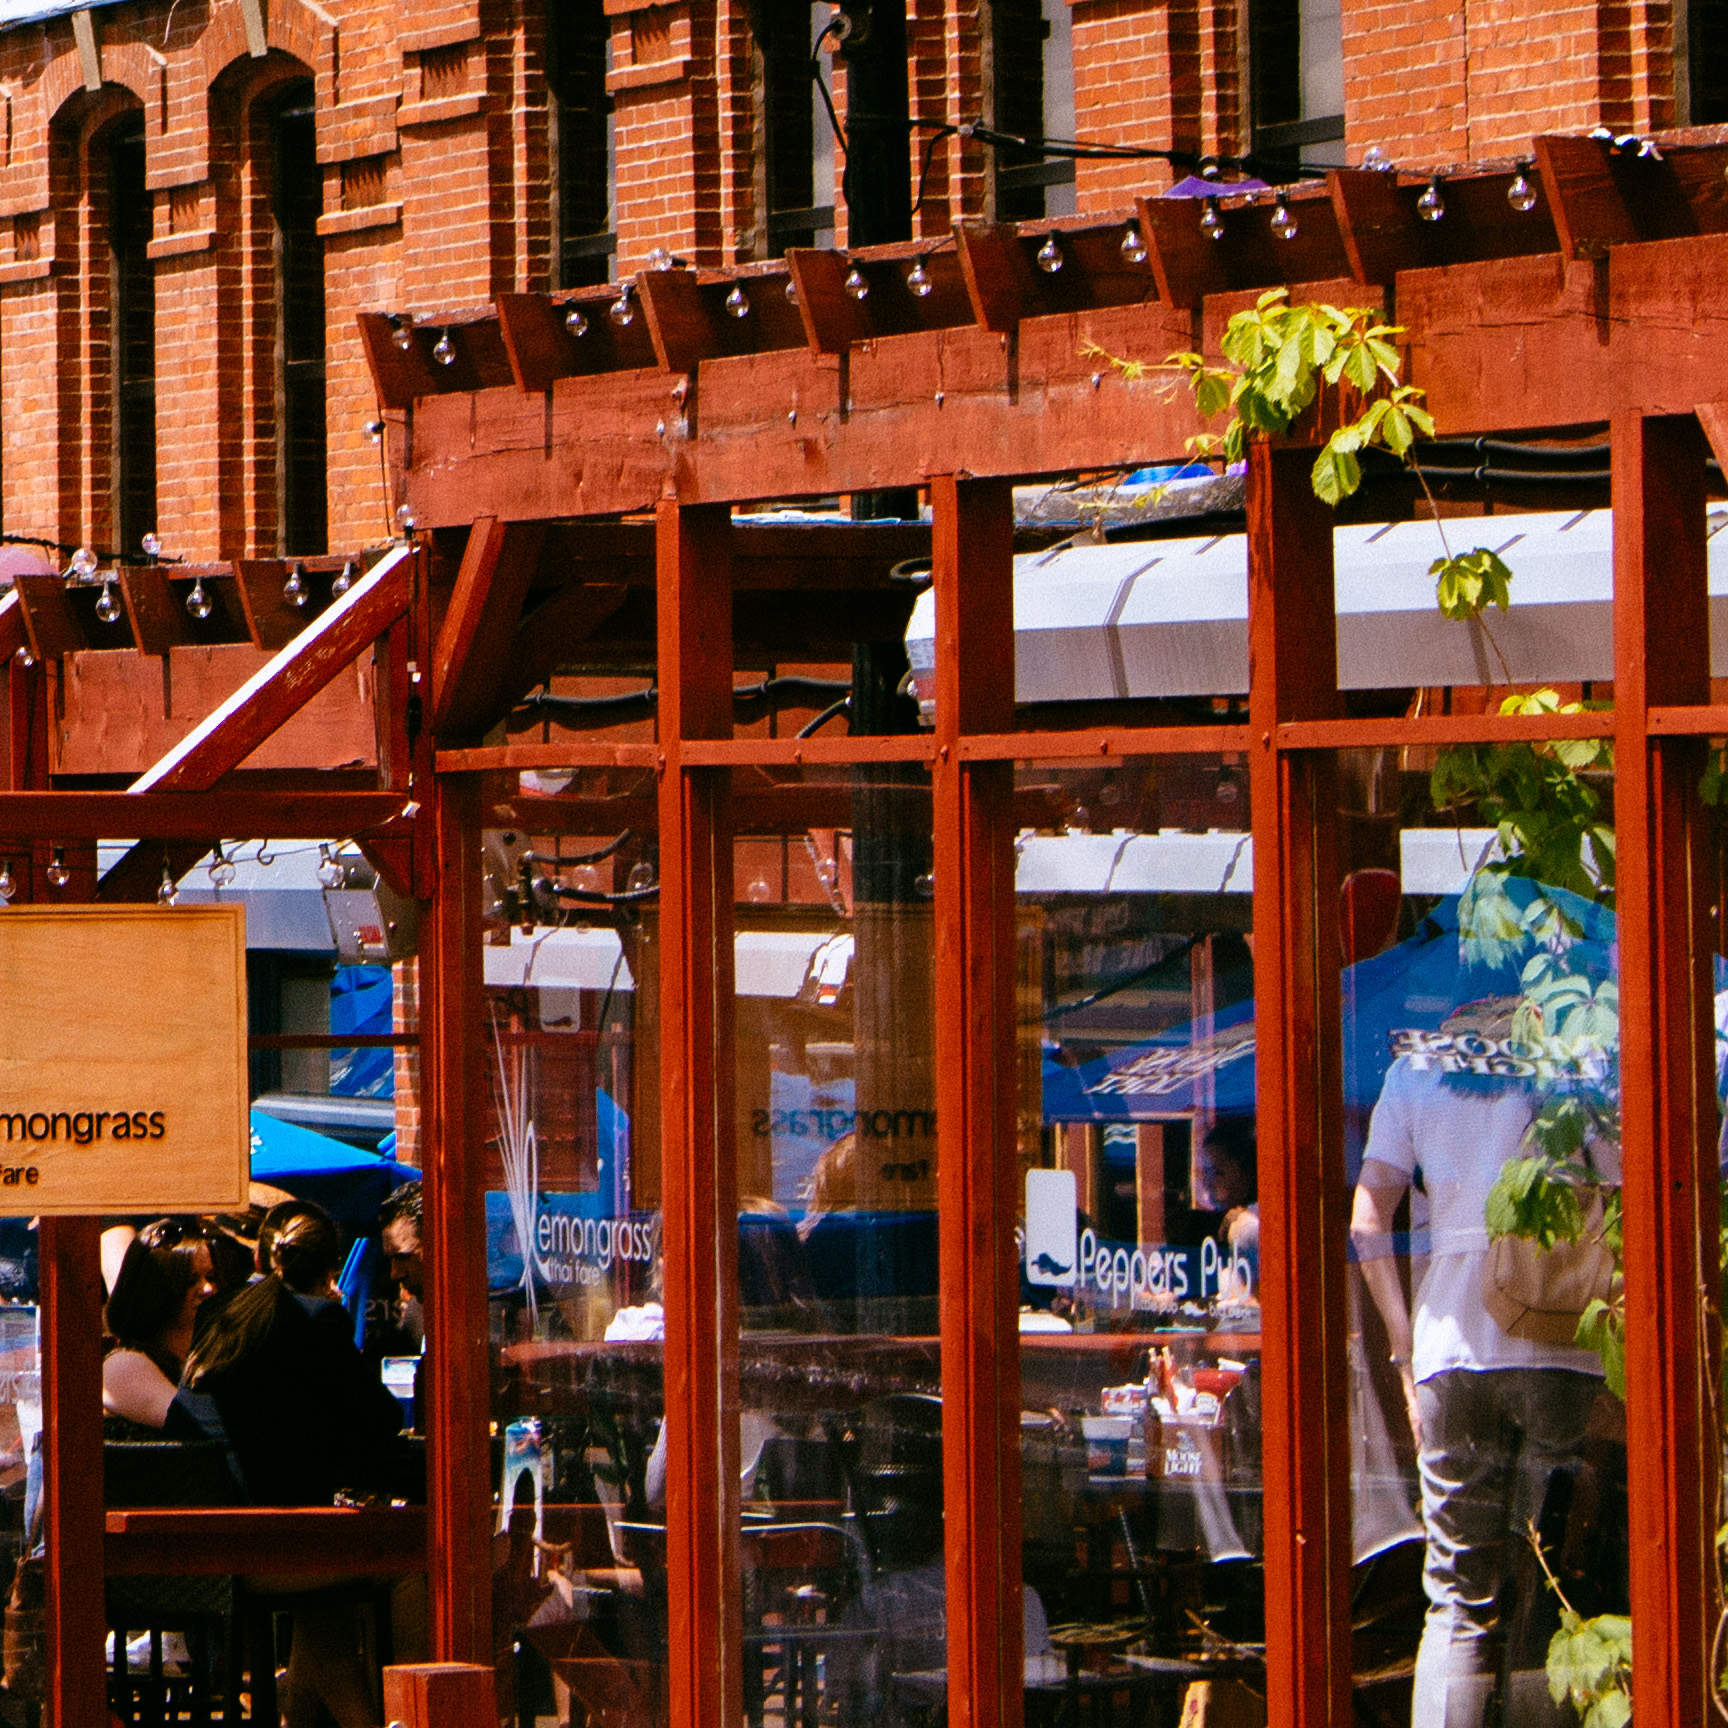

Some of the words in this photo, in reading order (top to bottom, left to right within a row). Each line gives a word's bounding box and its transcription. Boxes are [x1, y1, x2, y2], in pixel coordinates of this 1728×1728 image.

[575, 1258, 601, 1287] fare
[1080, 1227, 1189, 1309] Peppers
[1200, 1235, 1252, 1301] Pub
